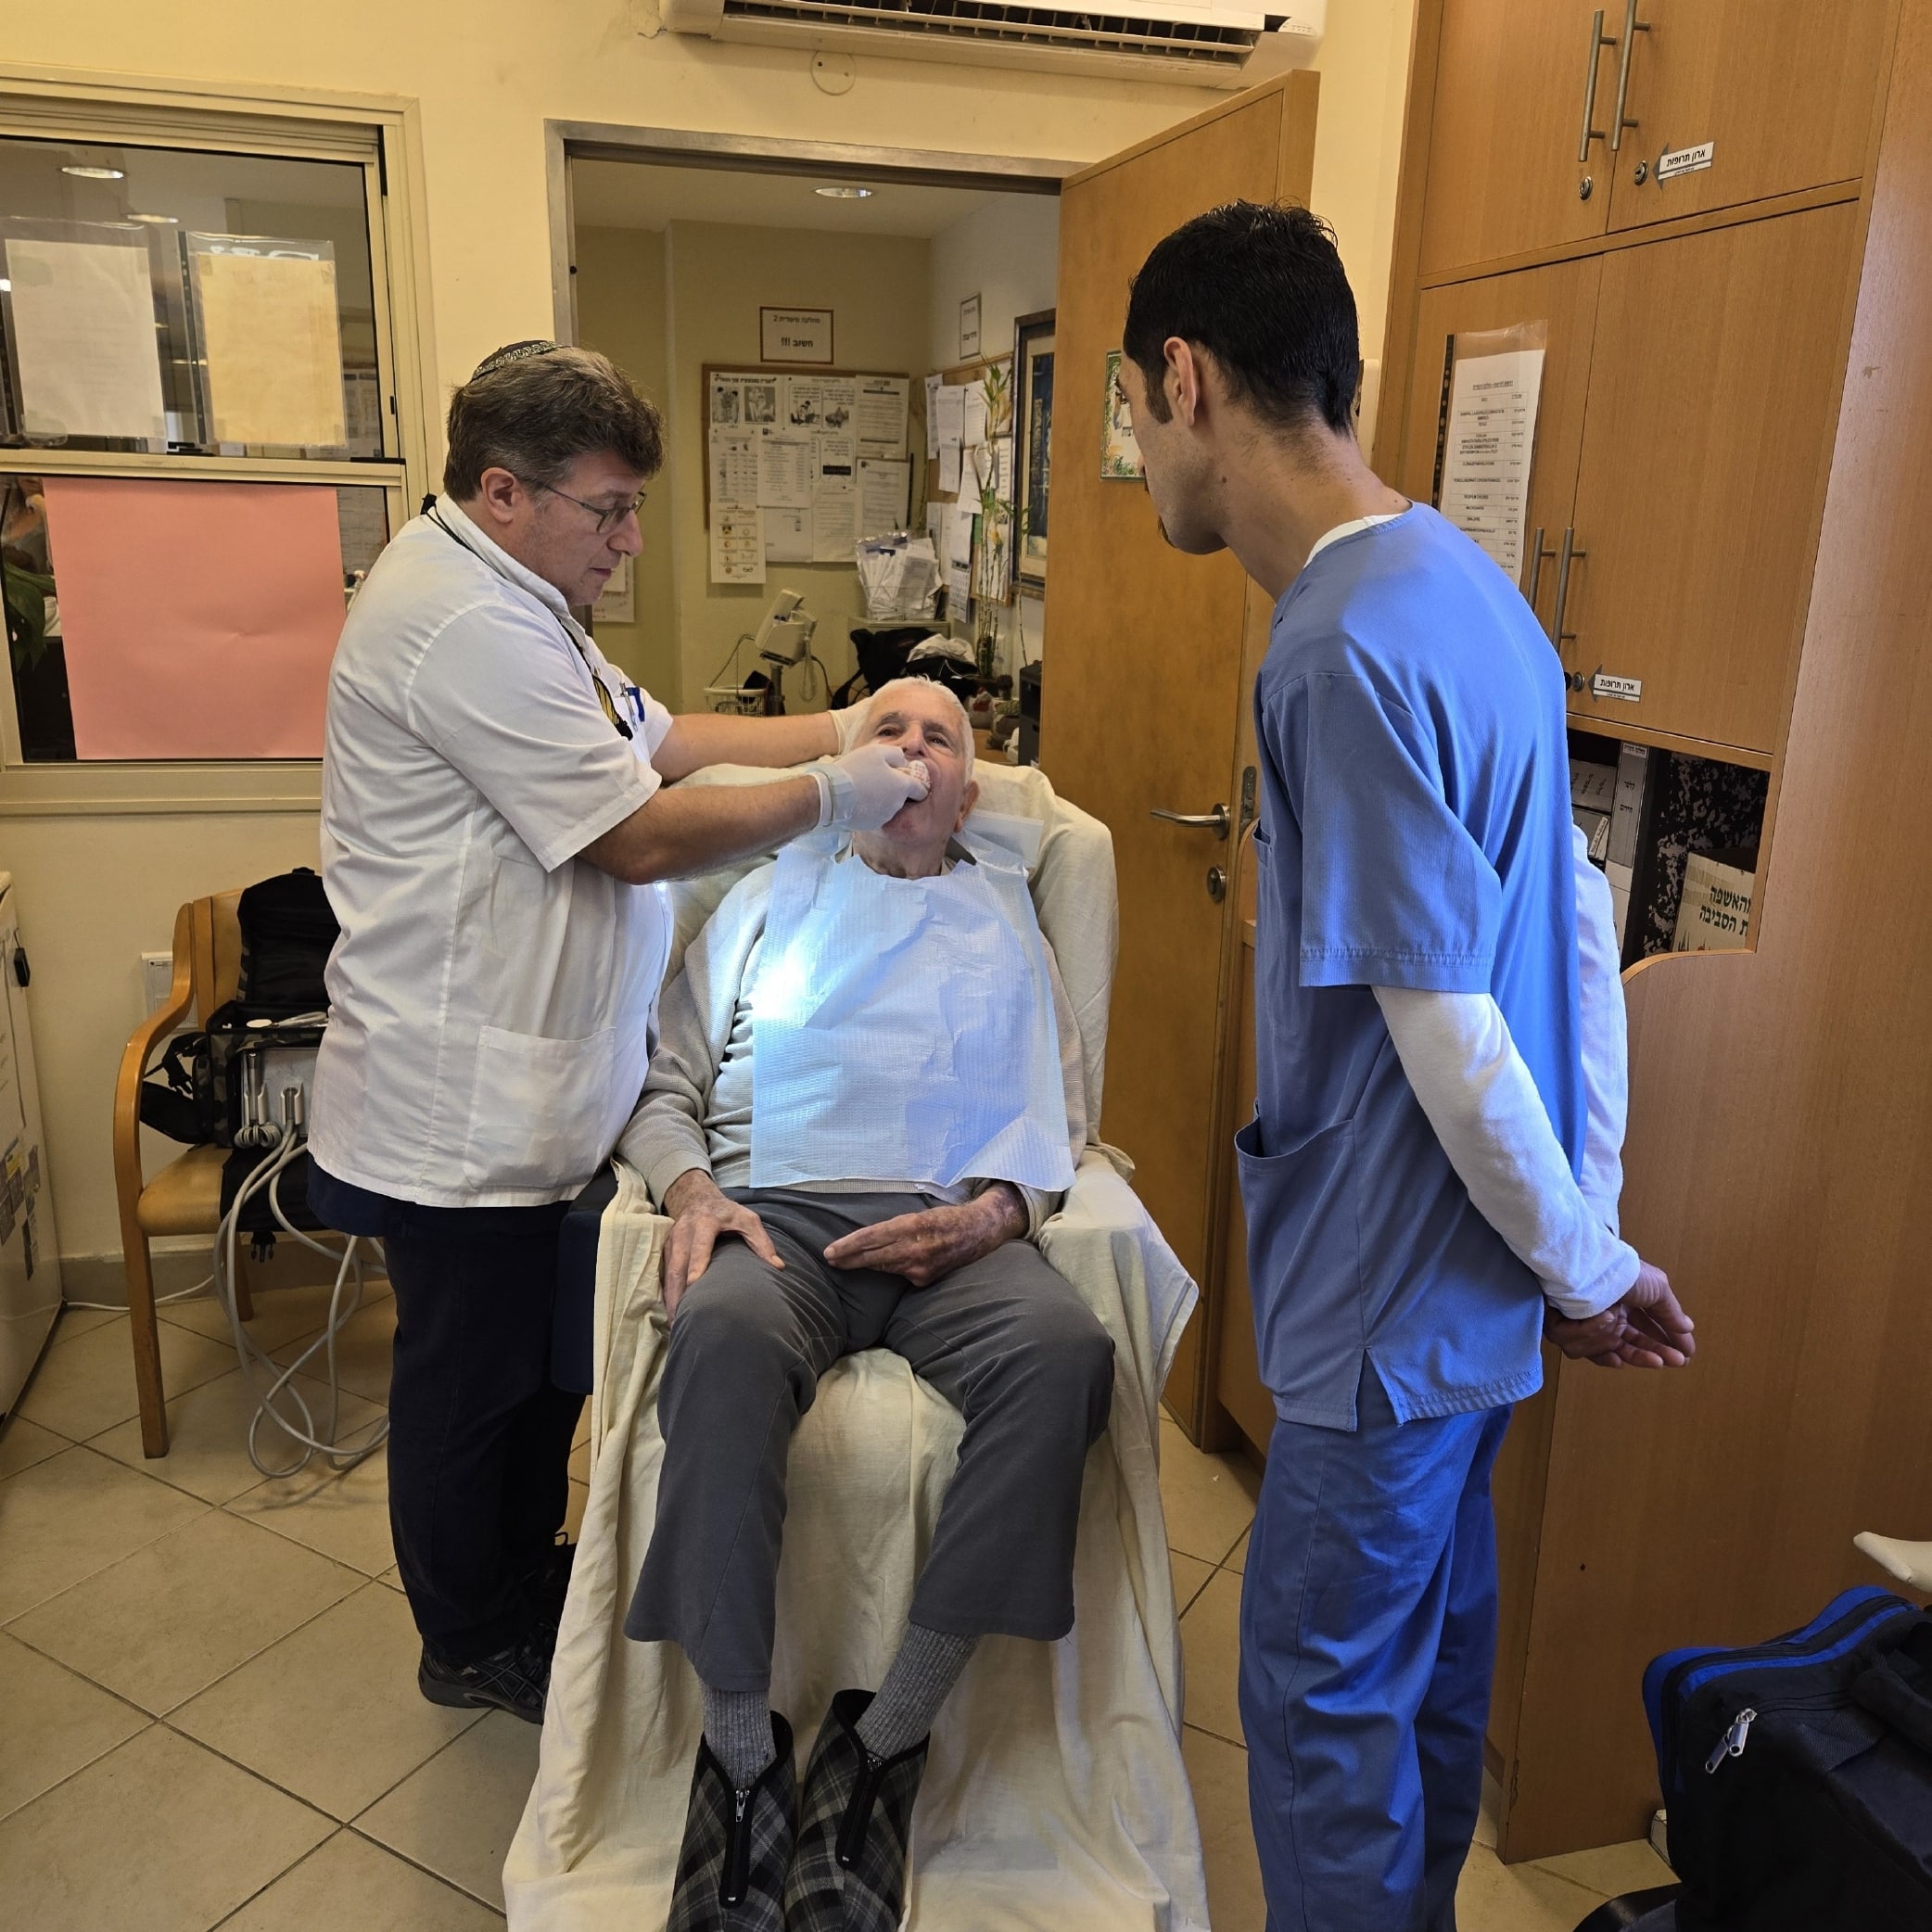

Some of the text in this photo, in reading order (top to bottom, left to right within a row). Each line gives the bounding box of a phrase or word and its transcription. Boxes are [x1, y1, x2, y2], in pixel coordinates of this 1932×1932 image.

[1666, 149, 1706, 167] ארון תרופות
[793, 339, 813, 348] חשוב
[1600, 679, 1634, 691] ארון תרופות
[1699, 904, 1737, 934] הסביבה
